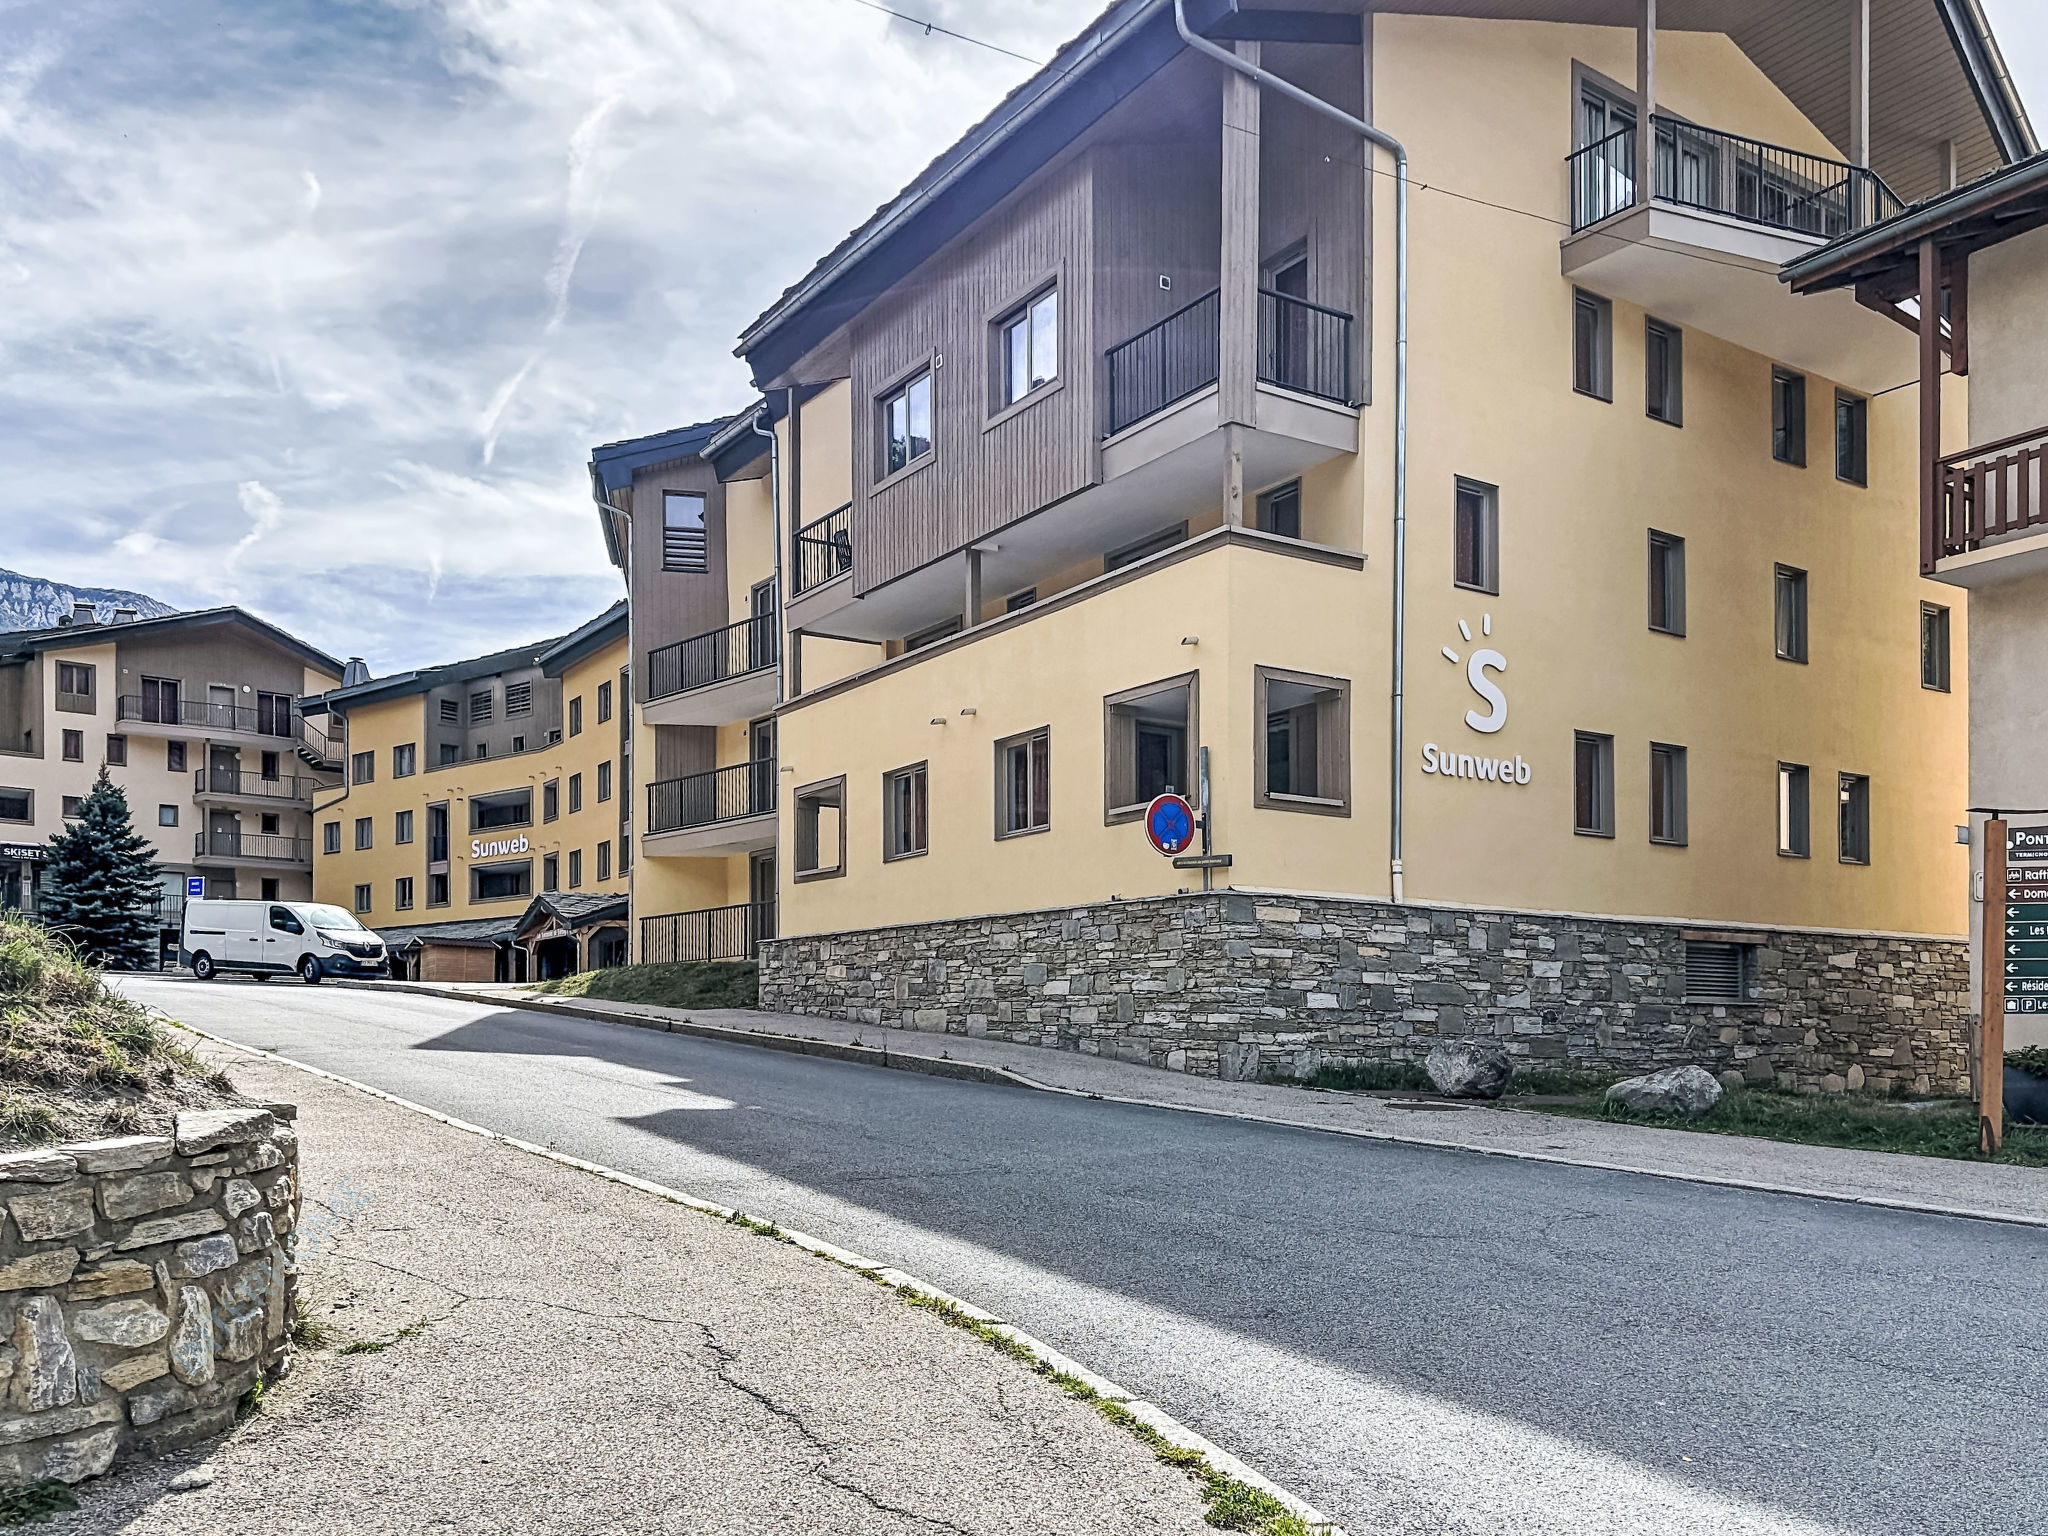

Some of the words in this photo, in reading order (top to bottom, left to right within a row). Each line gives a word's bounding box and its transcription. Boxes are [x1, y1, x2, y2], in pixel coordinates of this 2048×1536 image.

[1422, 742, 1531, 785] Sunweb
[471, 833, 529, 858] Sunweb
[2029, 925, 2045, 935] Les
